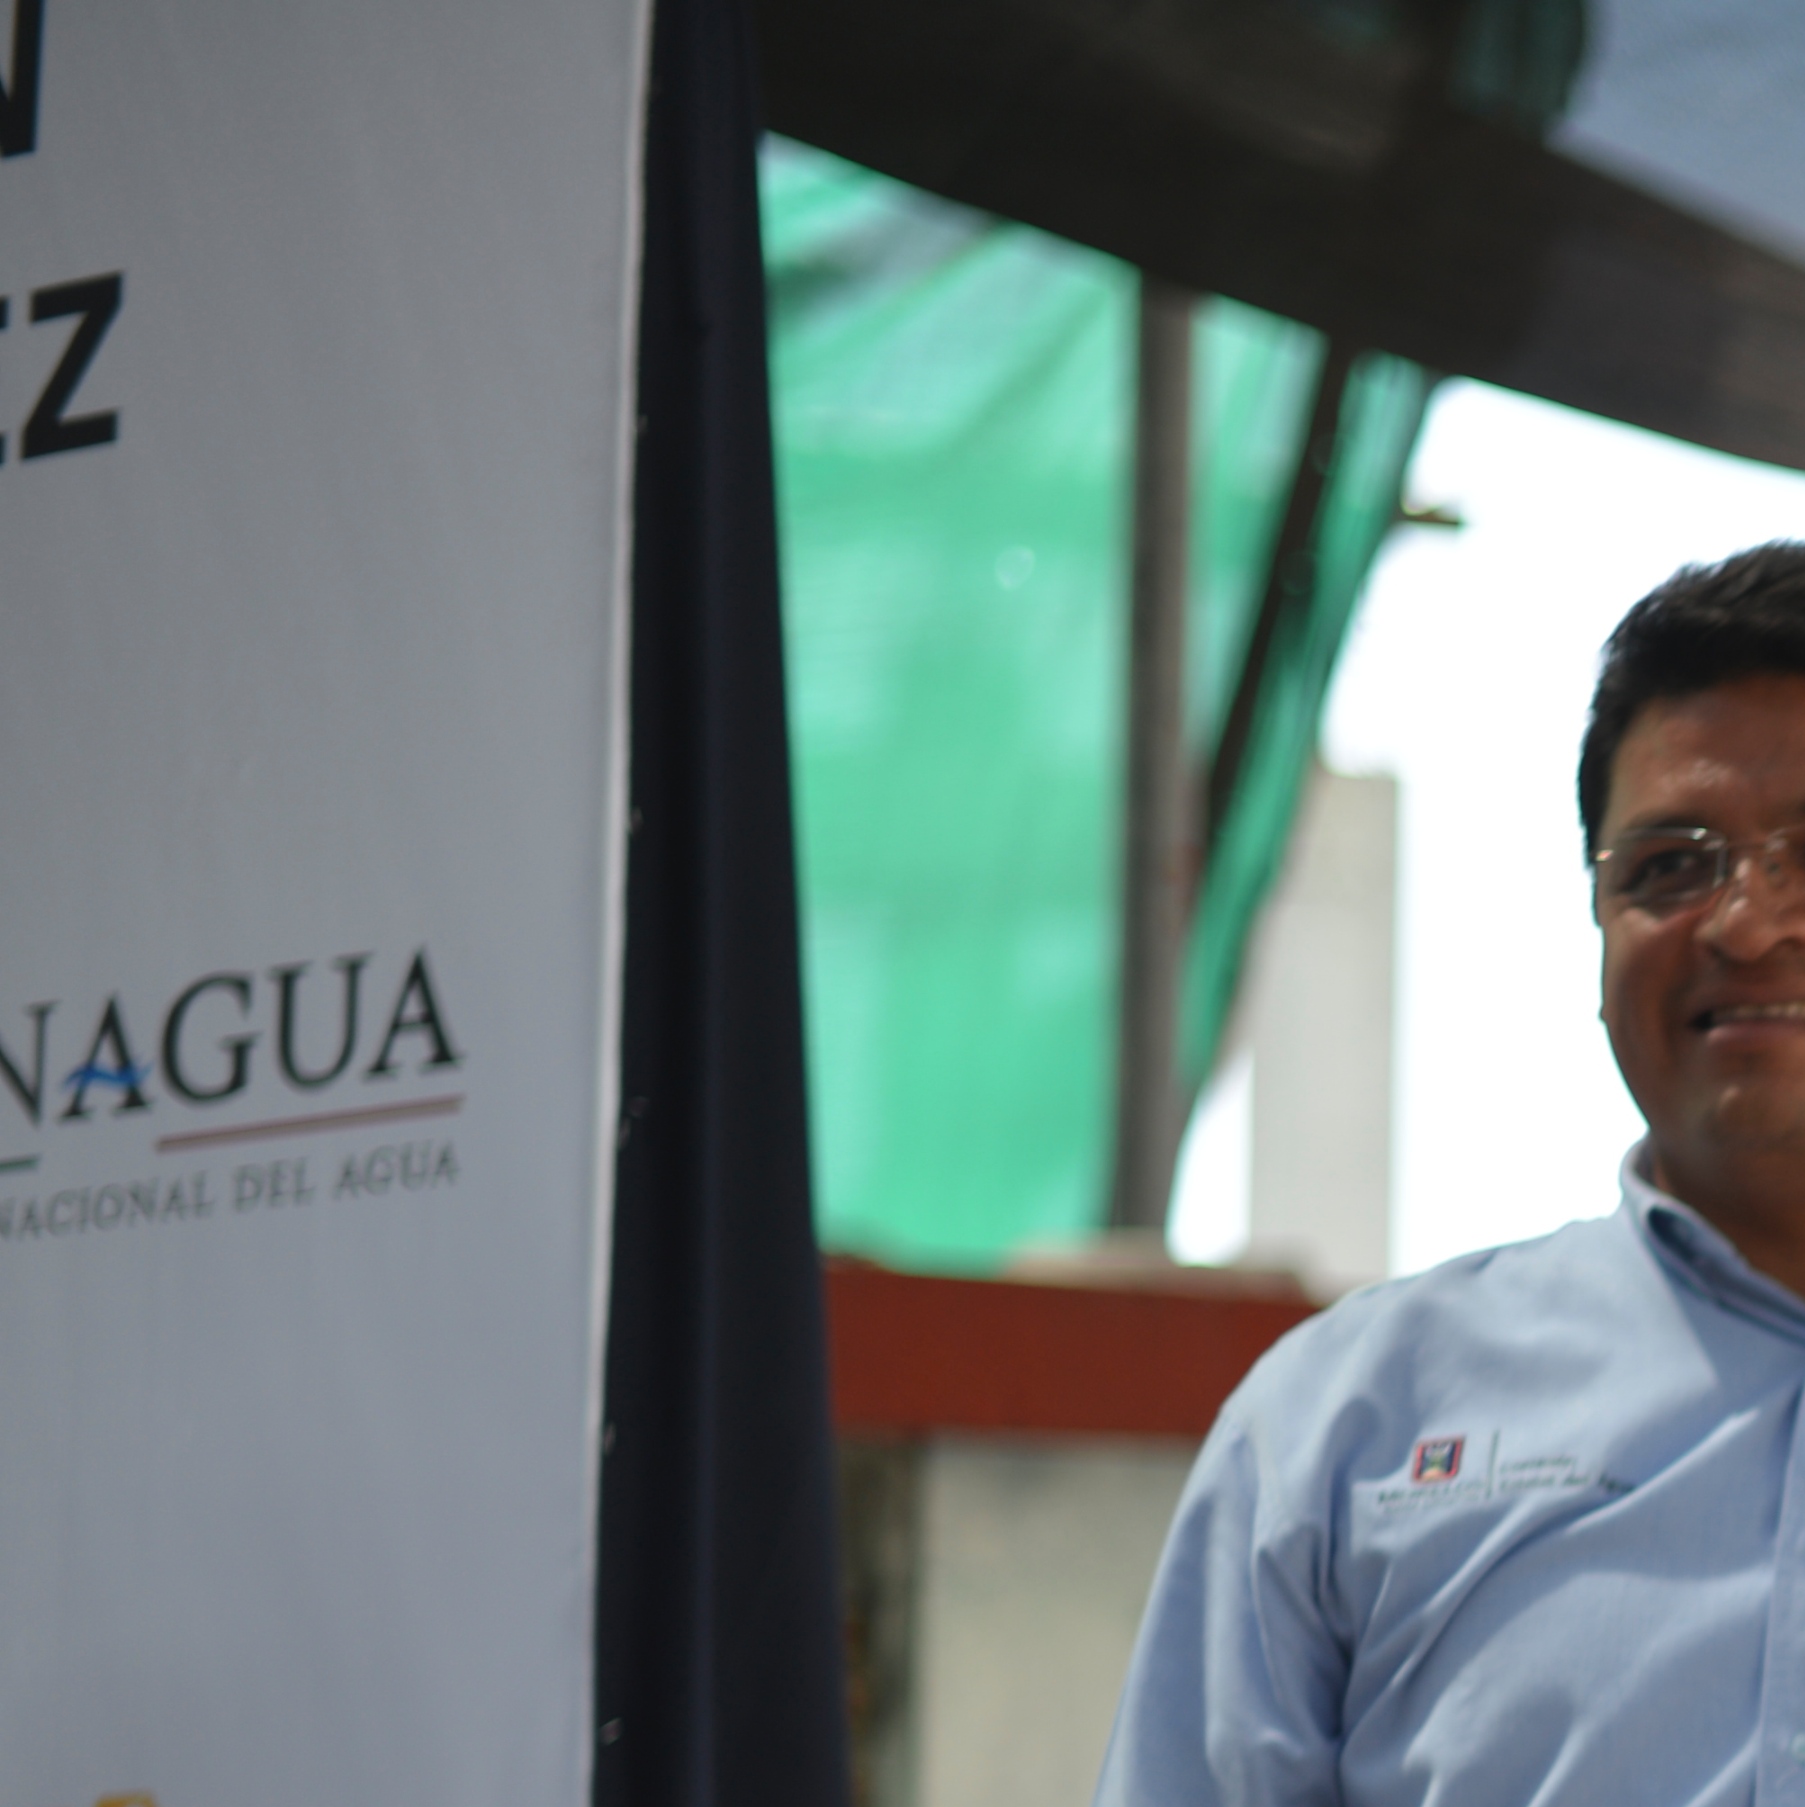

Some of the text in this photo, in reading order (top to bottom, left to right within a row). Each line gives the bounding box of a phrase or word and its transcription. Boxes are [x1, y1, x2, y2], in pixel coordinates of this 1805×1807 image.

[0, 271, 125, 467] Z
[233, 1156, 316, 1214] DEL
[335, 1138, 460, 1200] AGUA
